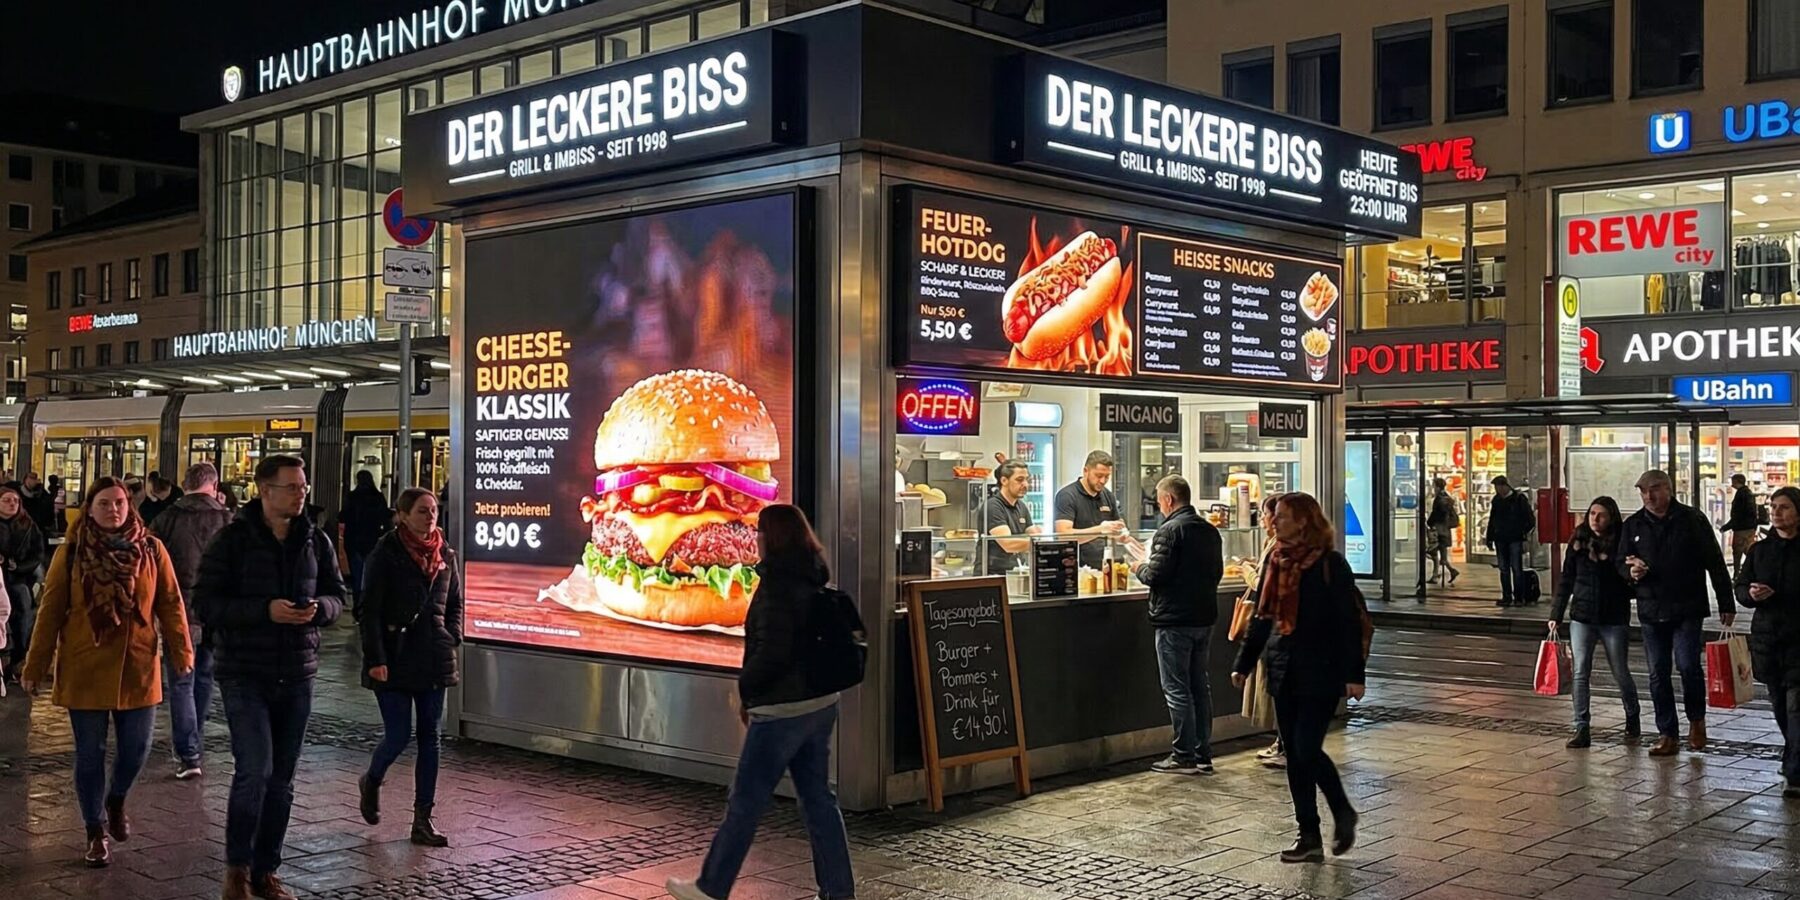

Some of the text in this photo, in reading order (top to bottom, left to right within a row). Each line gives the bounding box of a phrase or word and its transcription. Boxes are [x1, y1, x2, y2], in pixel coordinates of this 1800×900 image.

[259, 0, 485, 93] HAUPTBAHNHOF
[448, 51, 747, 166] DER LECKERE BISS
[1047, 74, 1323, 184] DER LECKERE BISS
[509, 156, 541, 177] GRILL
[543, 154, 552, 171] &
[554, 145, 595, 170] IMBISS
[606, 137, 634, 159] SEIT
[636, 130, 667, 153] 1998
[1361, 149, 1398, 175] HEUTE
[1398, 137, 1474, 172] WE
[1120, 150, 1154, 174] GRILL
[1156, 158, 1165, 176] &
[1167, 160, 1206, 184] IMBISS
[1215, 170, 1239, 191] SEIT
[1241, 177, 1266, 197] 1998
[1340, 168, 1418, 203] GEÖFFNET BIS
[1456, 166, 1487, 182] city
[921, 208, 992, 237] FEUER-
[1350, 195, 1408, 223] 23:00 UHR
[1568, 210, 1699, 256] REWE
[921, 233, 1006, 263] HOTDOG
[1675, 247, 1714, 266] city
[920, 260, 959, 275] SCHARF
[960, 262, 967, 276] &
[1174, 248, 1275, 279] HEISSE SNACKS
[920, 304, 966, 319] Nur 5,50 €
[173, 316, 376, 358] HAUPTBAHNHOF MÜNCHEN
[920, 319, 972, 342] 5,50 €
[476, 331, 571, 362] CHEESE-
[1345, 340, 1500, 374] POTHEKE
[477, 362, 569, 392] BURGER
[1692, 378, 1773, 401] UBahn
[476, 393, 571, 421] KLASSIK
[902, 392, 974, 420] OFFEN
[1105, 404, 1173, 425] EINGANG
[1263, 409, 1305, 431] MENÜ
[475, 427, 569, 442] SAFTIGER GENUSS!
[475, 446, 503, 459] Frisch
[537, 446, 554, 459] mit
[475, 461, 550, 475] 100% Rindfleisch
[475, 477, 524, 490] & Cheddar.
[475, 502, 551, 518] Jetzt probieren!
[475, 521, 542, 550] 8,90 €
[935, 640, 992, 668] Burger +
[937, 667, 999, 688] Pommes +
[943, 687, 1000, 714] Drink für
[952, 707, 1009, 741] €14,90!
